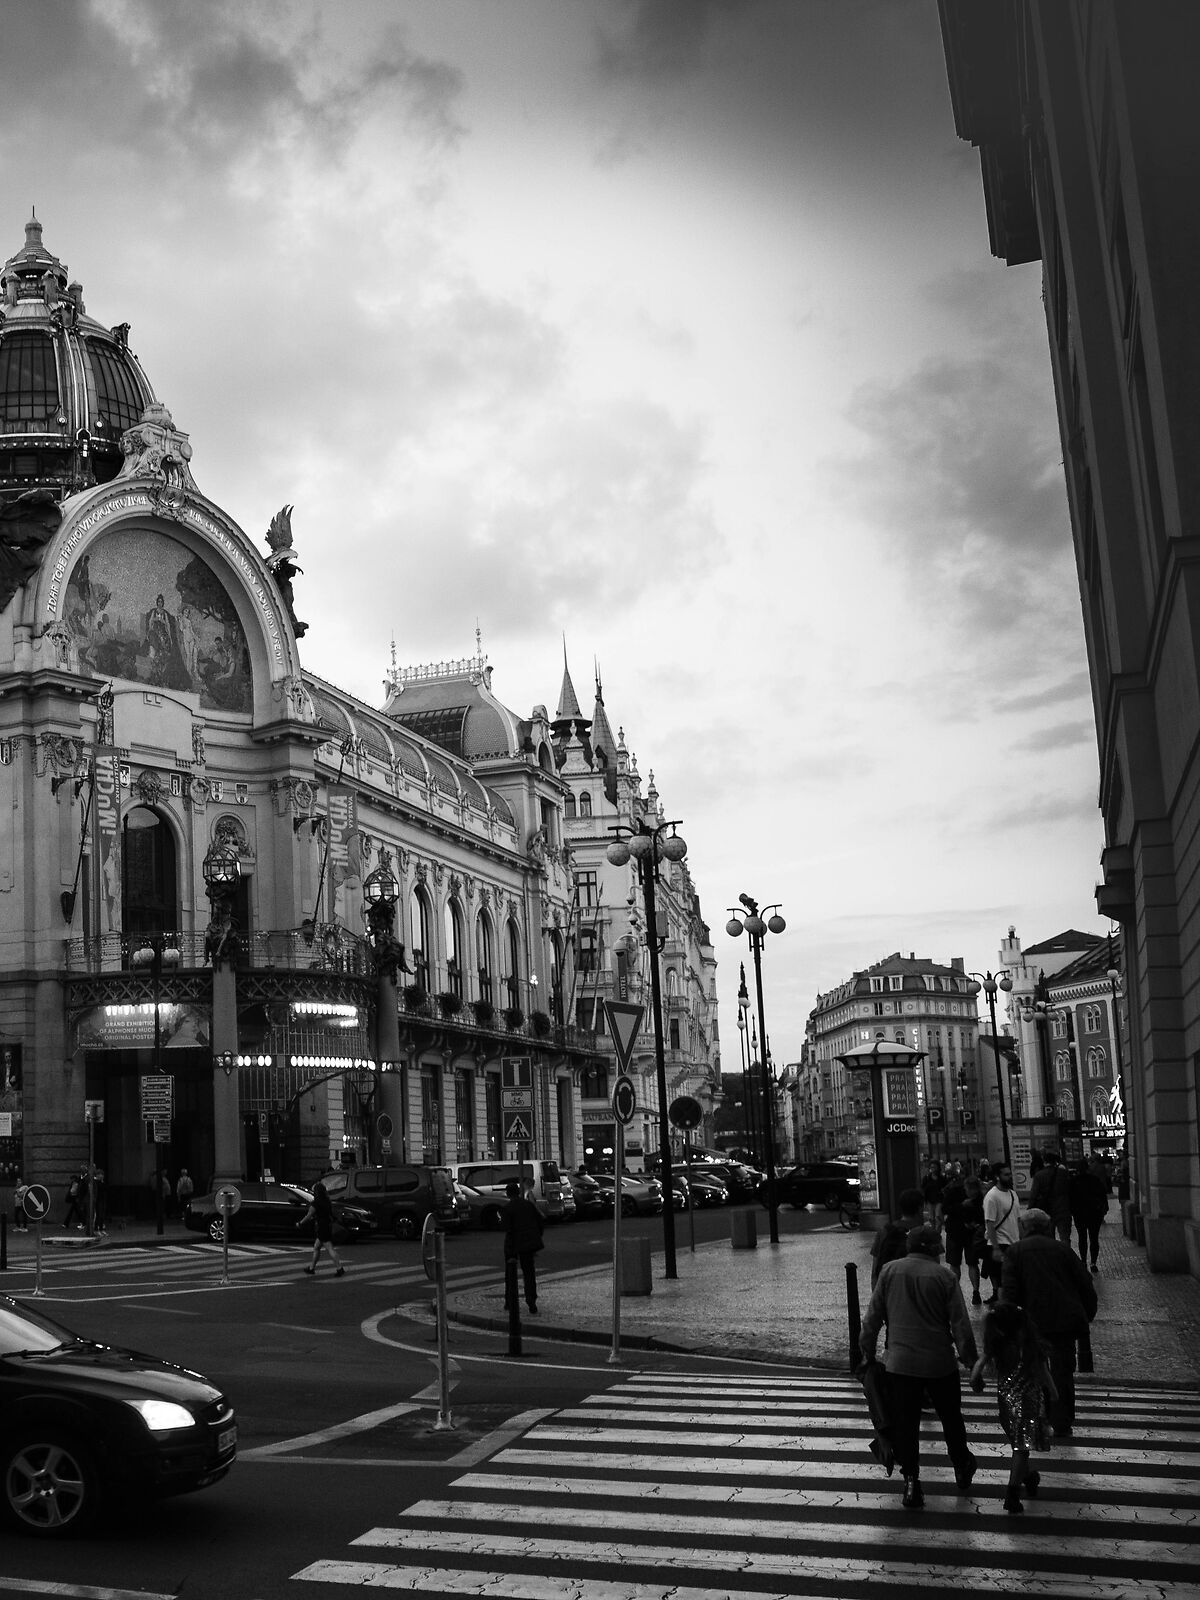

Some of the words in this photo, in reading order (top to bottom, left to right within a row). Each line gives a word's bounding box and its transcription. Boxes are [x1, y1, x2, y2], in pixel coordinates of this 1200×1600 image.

[929, 1109, 941, 1125] P
[962, 1111, 972, 1125] P
[1044, 1106, 1053, 1117] P
